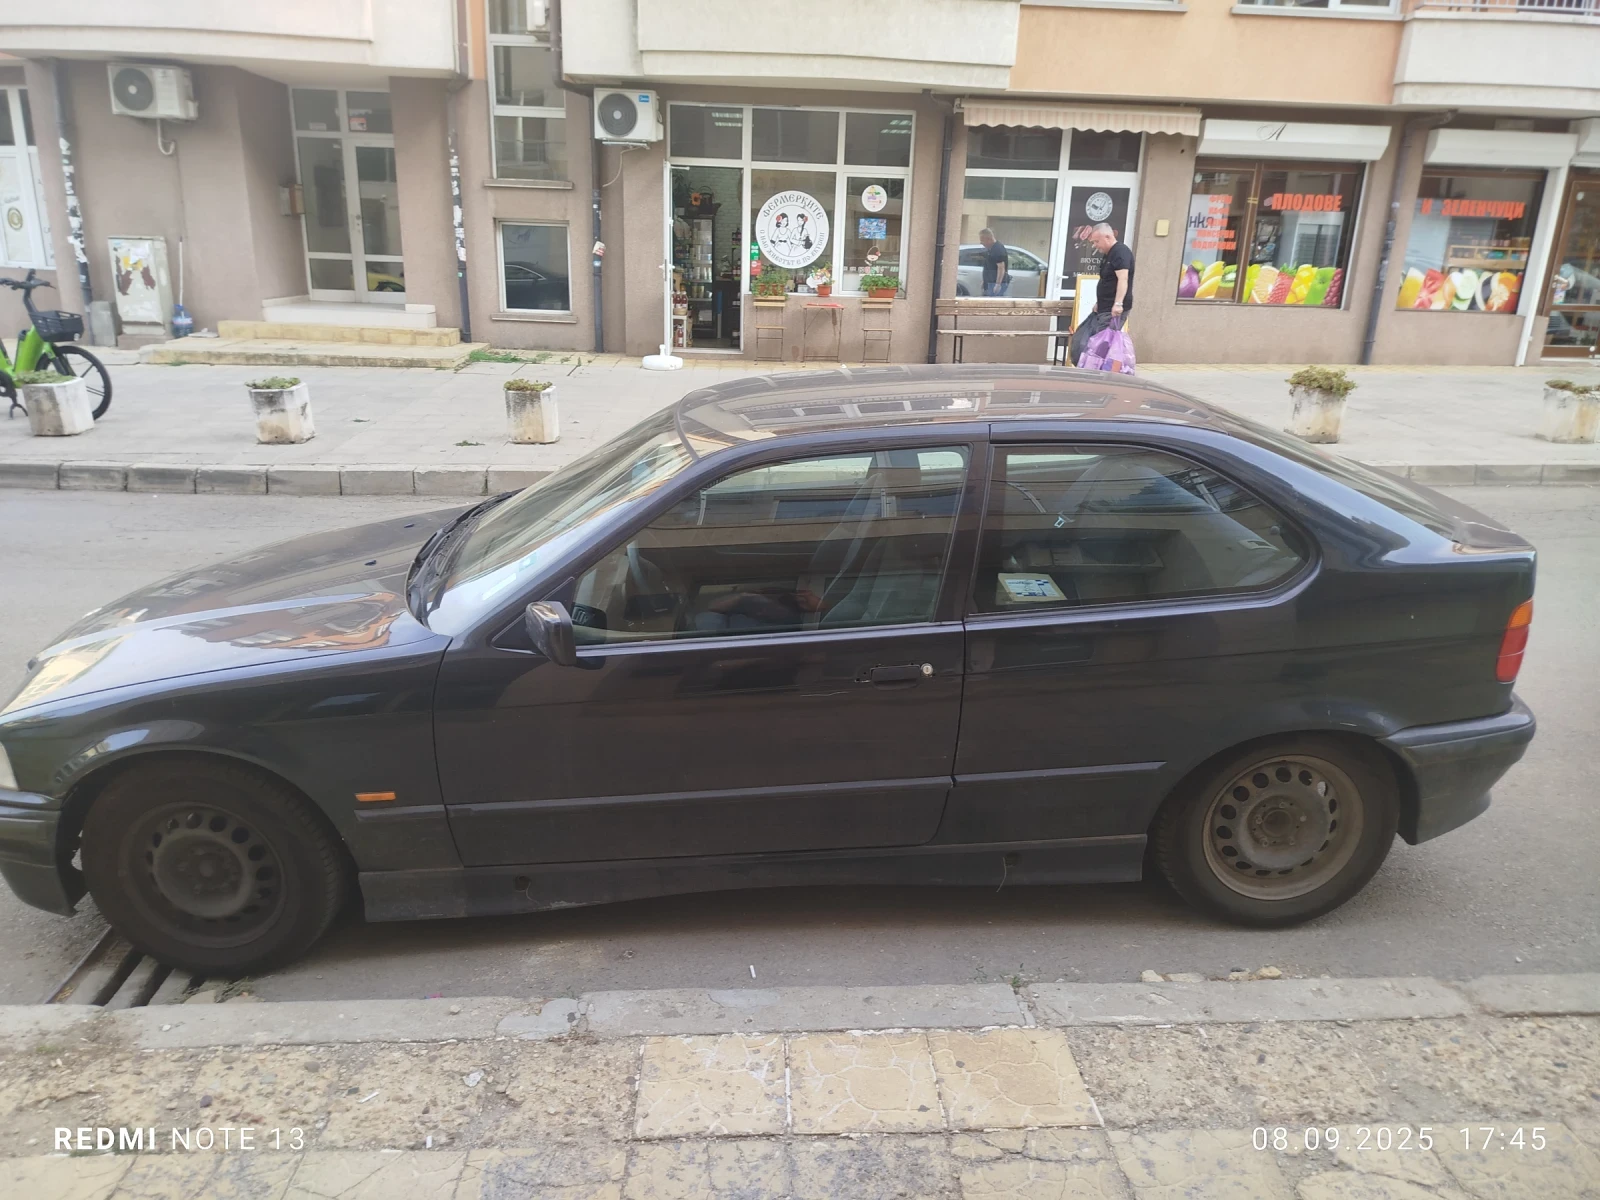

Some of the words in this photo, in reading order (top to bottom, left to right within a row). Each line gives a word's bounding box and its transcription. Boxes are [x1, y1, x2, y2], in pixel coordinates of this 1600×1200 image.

[762, 193, 825, 220] ФЕРМЕРКИТЕ
[1271, 193, 1343, 212] ПЛОДОВЕ
[1421, 197, 1433, 215] И
[1441, 198, 1526, 220] ЗЕЛЕНЧУЦИ
